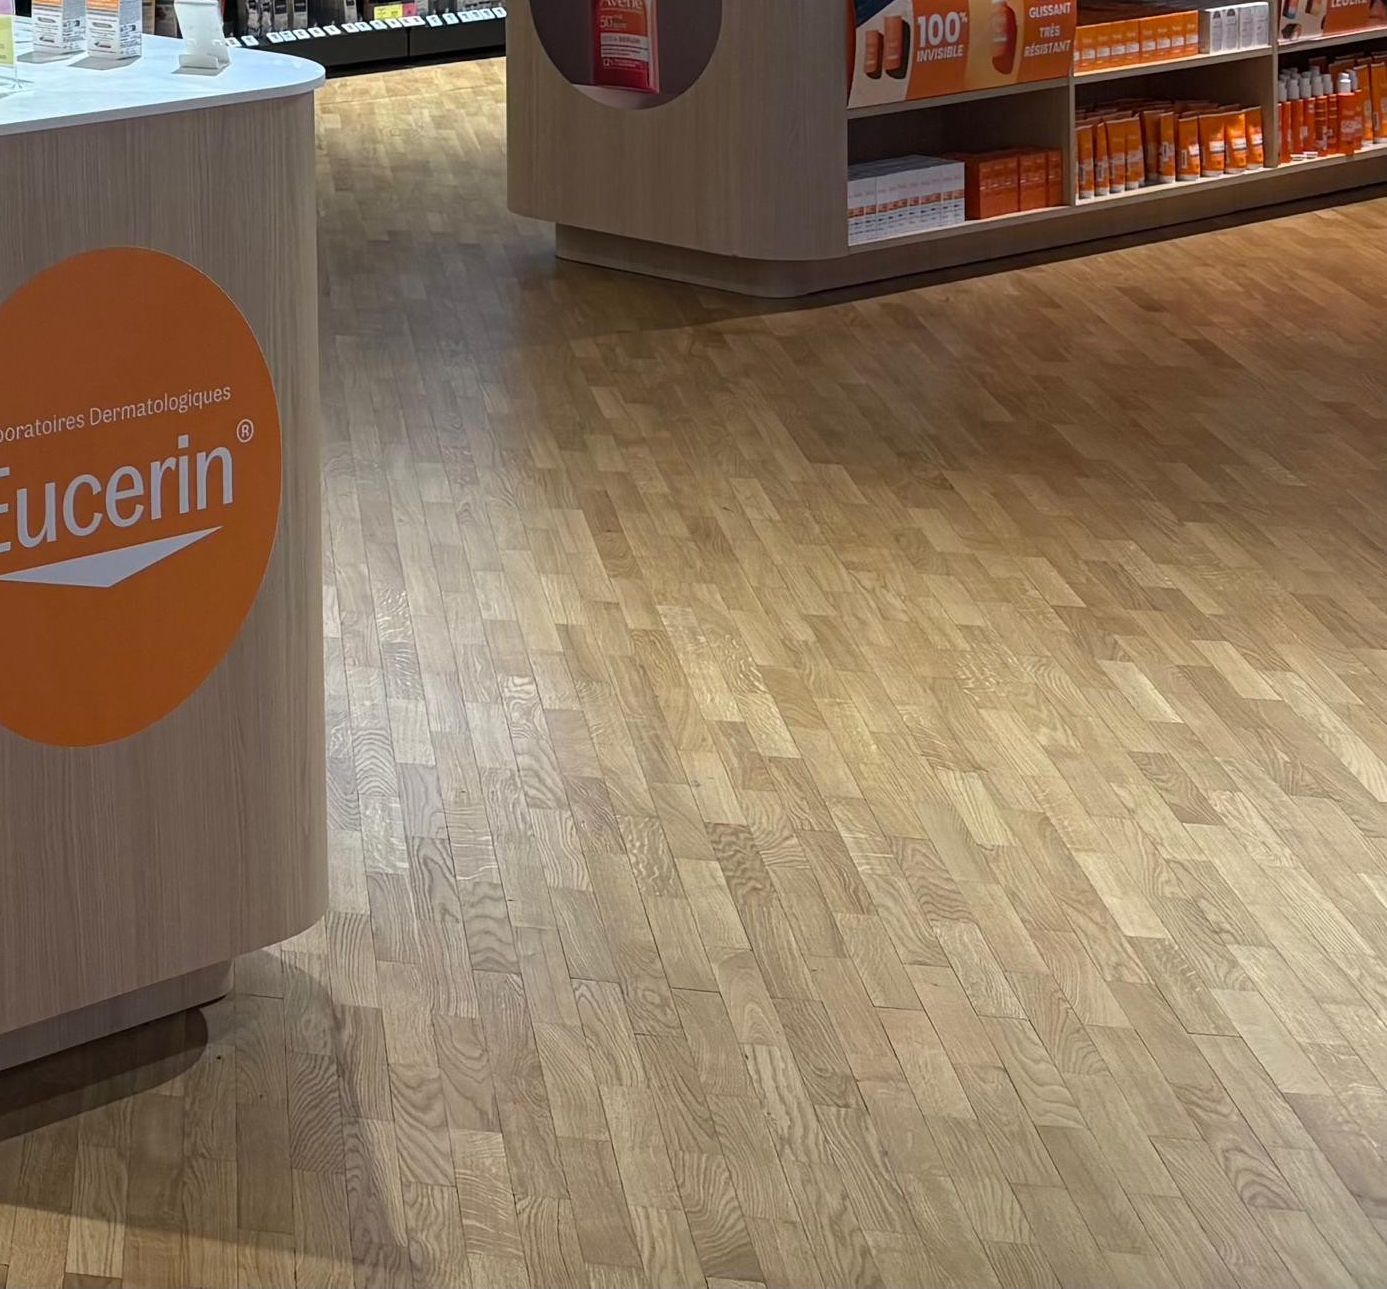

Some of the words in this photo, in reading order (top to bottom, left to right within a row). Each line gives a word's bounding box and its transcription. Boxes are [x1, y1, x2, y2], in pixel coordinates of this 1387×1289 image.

[1028, 2, 1072, 19] GLISSANT
[917, 11, 968, 47] 100%
[917, 44, 964, 62] INVISIBLE
[1024, 39, 1072, 57] RÉSISTANT
[89, 384, 232, 426] Dermatologiques
